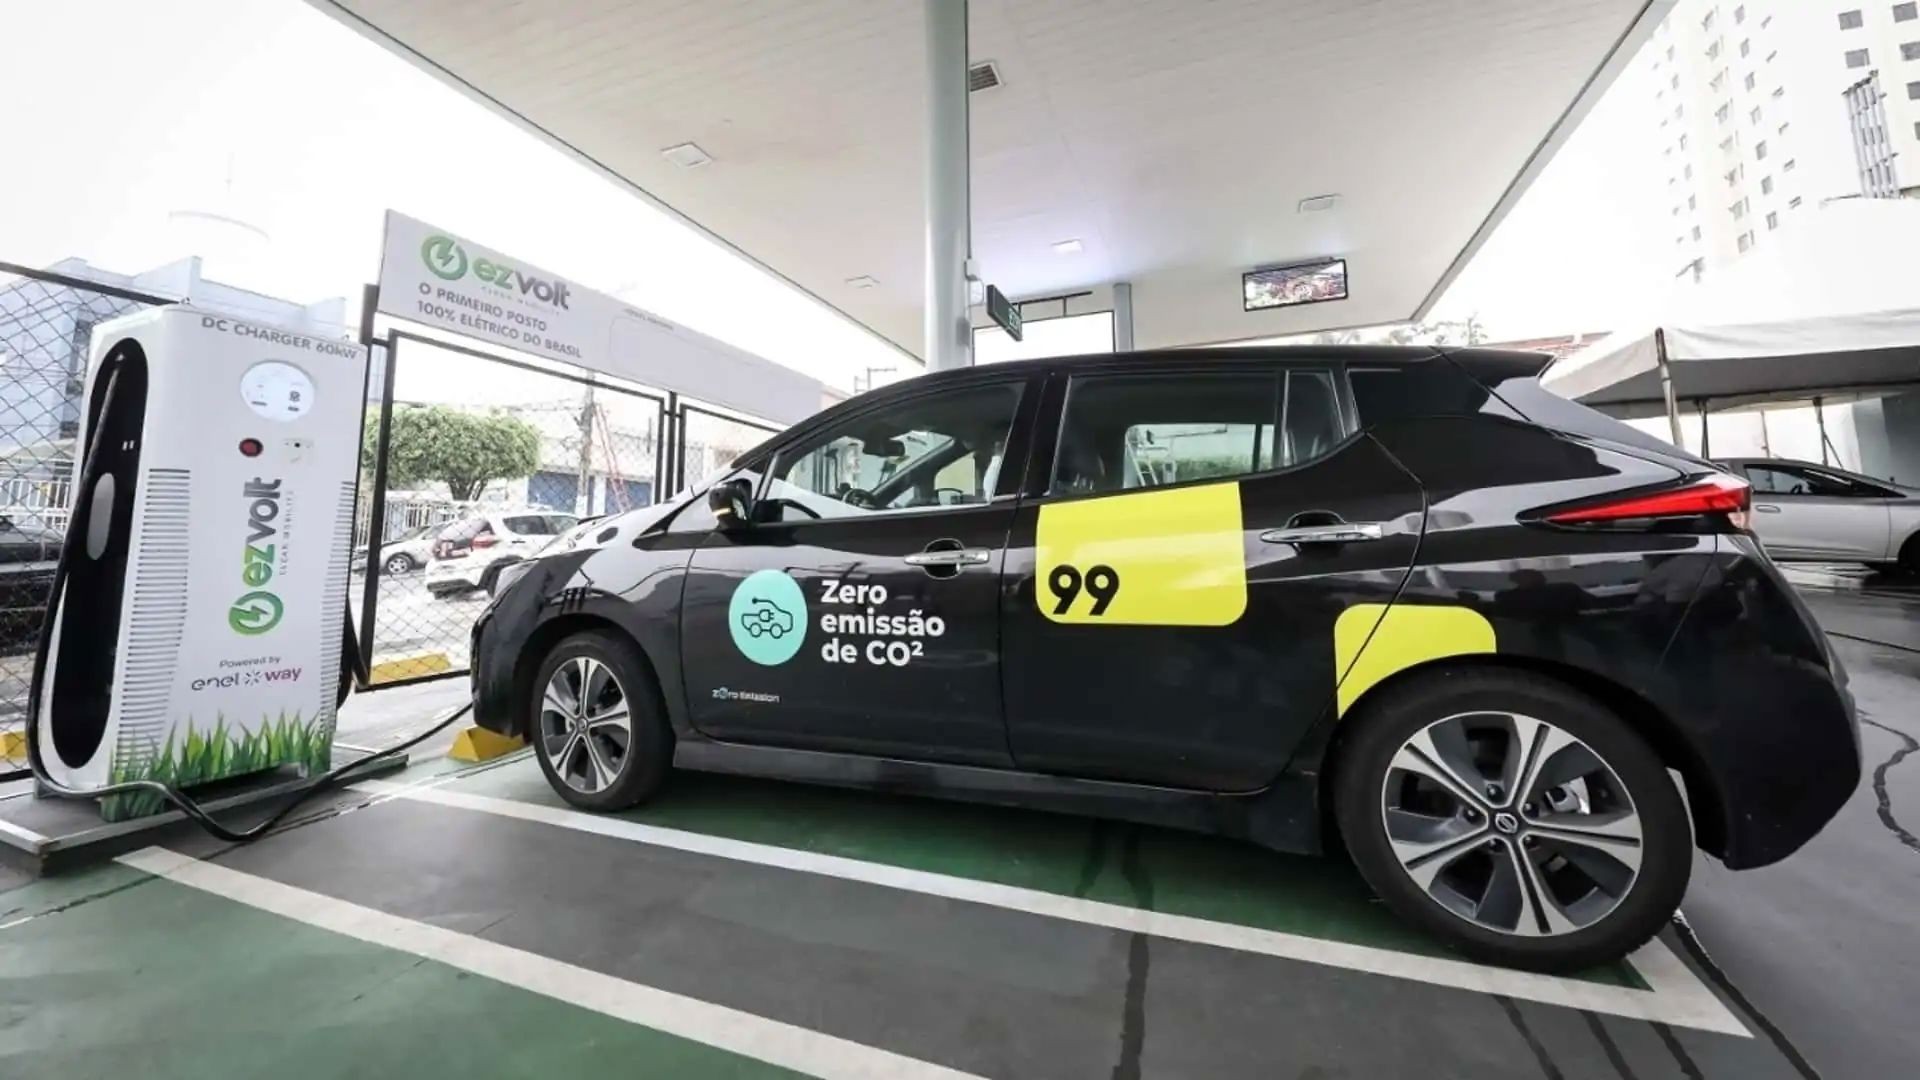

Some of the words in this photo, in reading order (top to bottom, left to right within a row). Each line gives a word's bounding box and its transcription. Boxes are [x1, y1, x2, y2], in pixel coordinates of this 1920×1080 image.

[472, 257, 571, 310] ezvolt
[418, 282, 432, 295] O
[436, 287, 503, 318] PRIMEIRO
[506, 310, 548, 332] POSTO
[201, 316, 229, 332] DC
[233, 323, 311, 350] CHARGER
[315, 342, 358, 360] 60kW
[417, 300, 456, 322] 100%
[460, 313, 519, 340] ELÉTRICO
[522, 332, 542, 346] DO
[544, 338, 583, 359] BRASIL
[243, 476, 282, 587] ezvolt
[820, 579, 888, 605] Zero
[1048, 563, 1121, 617] 99
[820, 608, 946, 637] emissão
[219, 656, 267, 668] Powered
[268, 655, 281, 664] by
[821, 637, 858, 664] de
[191, 672, 239, 691] enel
[264, 667, 302, 682] way
